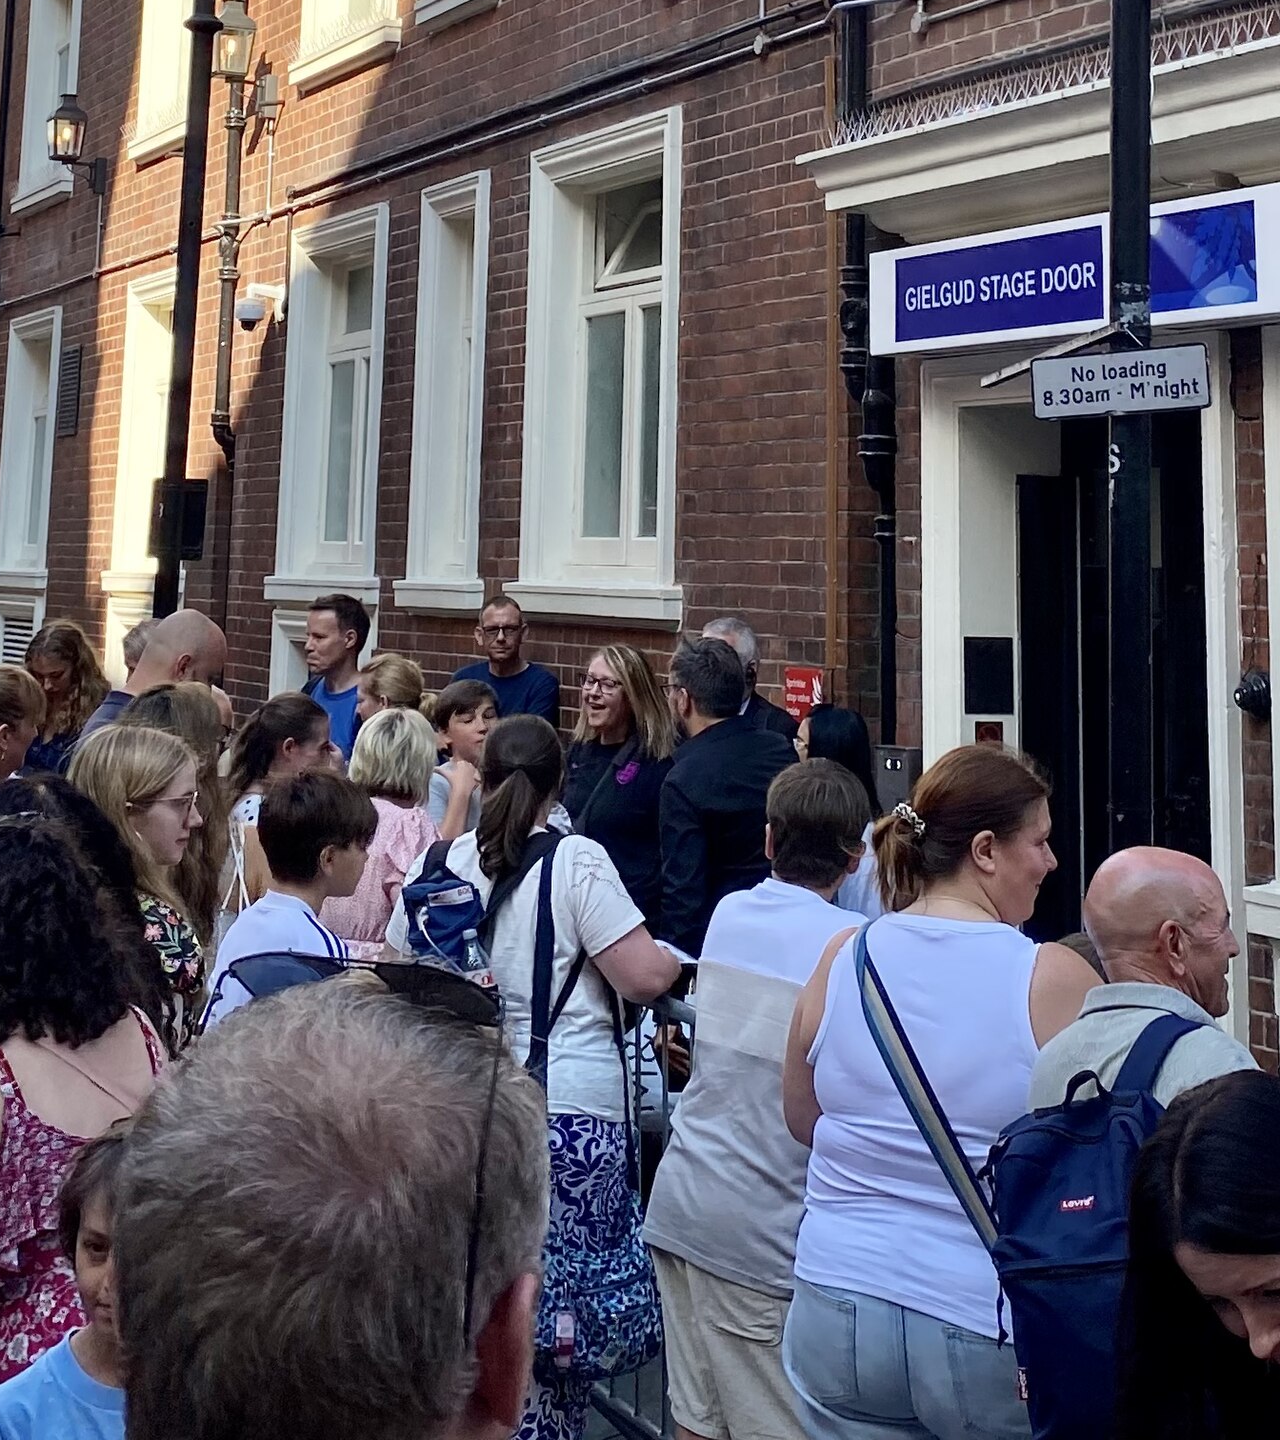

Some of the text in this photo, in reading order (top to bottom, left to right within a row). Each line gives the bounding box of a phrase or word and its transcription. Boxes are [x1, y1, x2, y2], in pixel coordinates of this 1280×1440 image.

[904, 261, 1097, 312] GIELGUD STAGE DOOR
[1071, 360, 1167, 383] No loading
[1042, 387, 1111, 407] 8.30am
[1130, 378, 1200, 402] M'night
